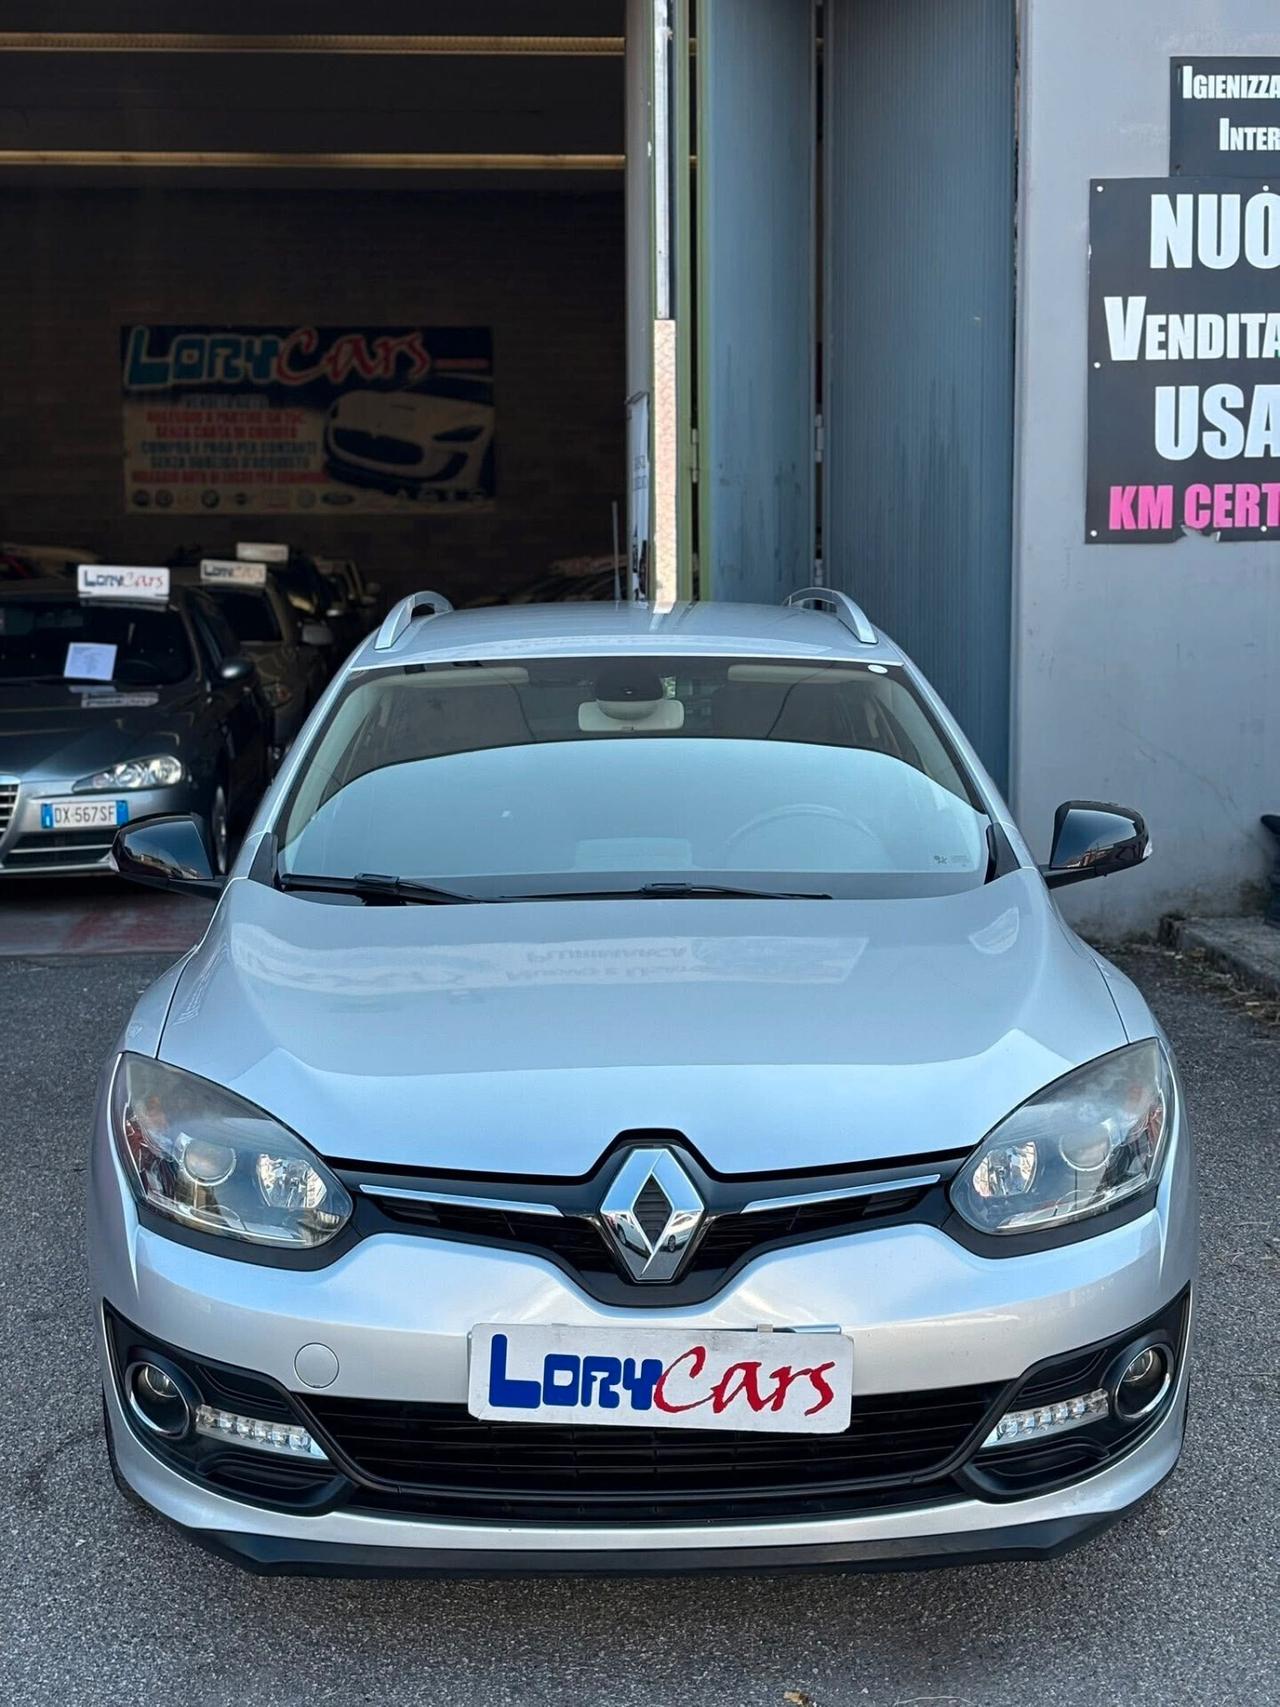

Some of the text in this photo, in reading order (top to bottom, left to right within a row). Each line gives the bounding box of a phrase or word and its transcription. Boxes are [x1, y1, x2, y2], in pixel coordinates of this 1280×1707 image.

[1150, 192, 1280, 270] NUO
[1154, 383, 1280, 461] USA
[1109, 483, 1280, 530] KM CERT
